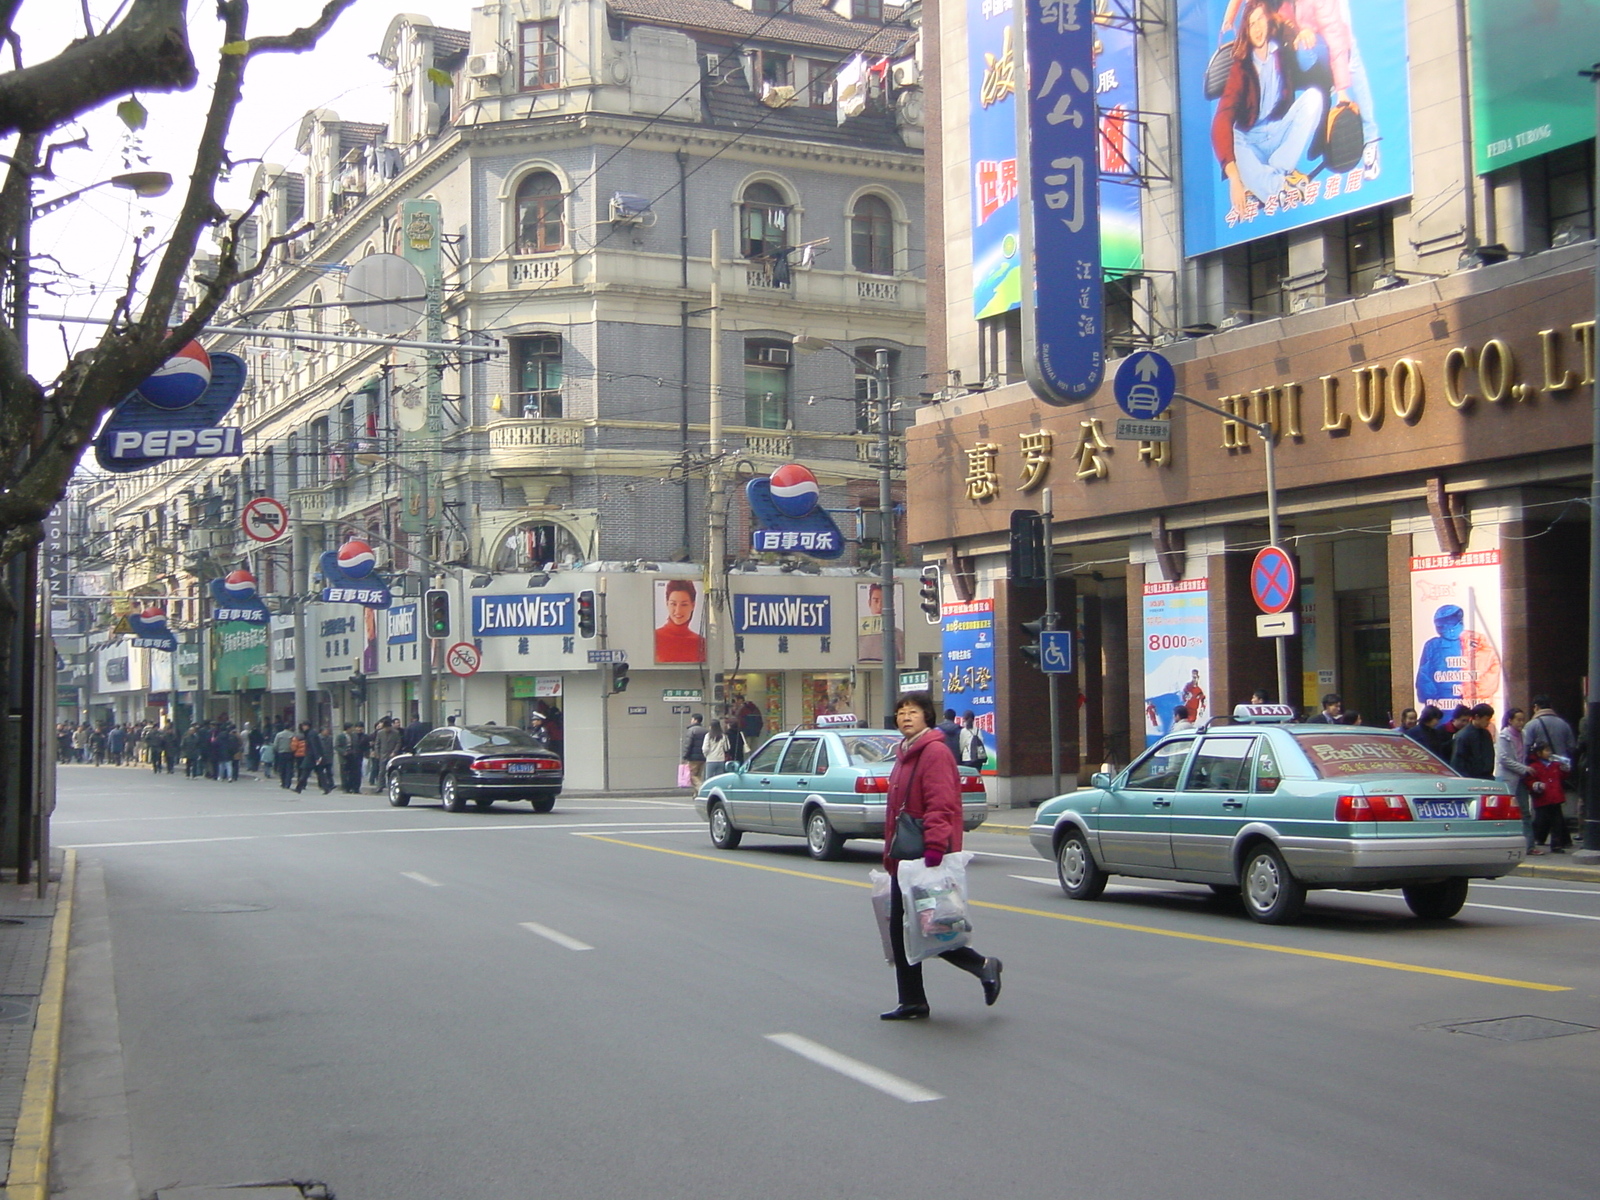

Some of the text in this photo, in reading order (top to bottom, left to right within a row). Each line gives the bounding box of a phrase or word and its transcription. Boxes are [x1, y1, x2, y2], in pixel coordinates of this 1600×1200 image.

[1225, 168, 1366, 228] 今年冬天穿雅鹿
[1219, 382, 1303, 449] HUI
[1319, 357, 1424, 432] LUO
[113, 428, 236, 458] PEPSI
[763, 531, 834, 550] 百事可乐
[328, 588, 383, 603] 百事可乐
[218, 608, 263, 620] 百事可乐
[133, 637, 171, 649] 百事可乐
[1446, 657, 1468, 667] THIS
[1434, 671, 1478, 681] GARMENT
[1453, 686, 1462, 695] IS
[1248, 705, 1288, 715] TAXI
